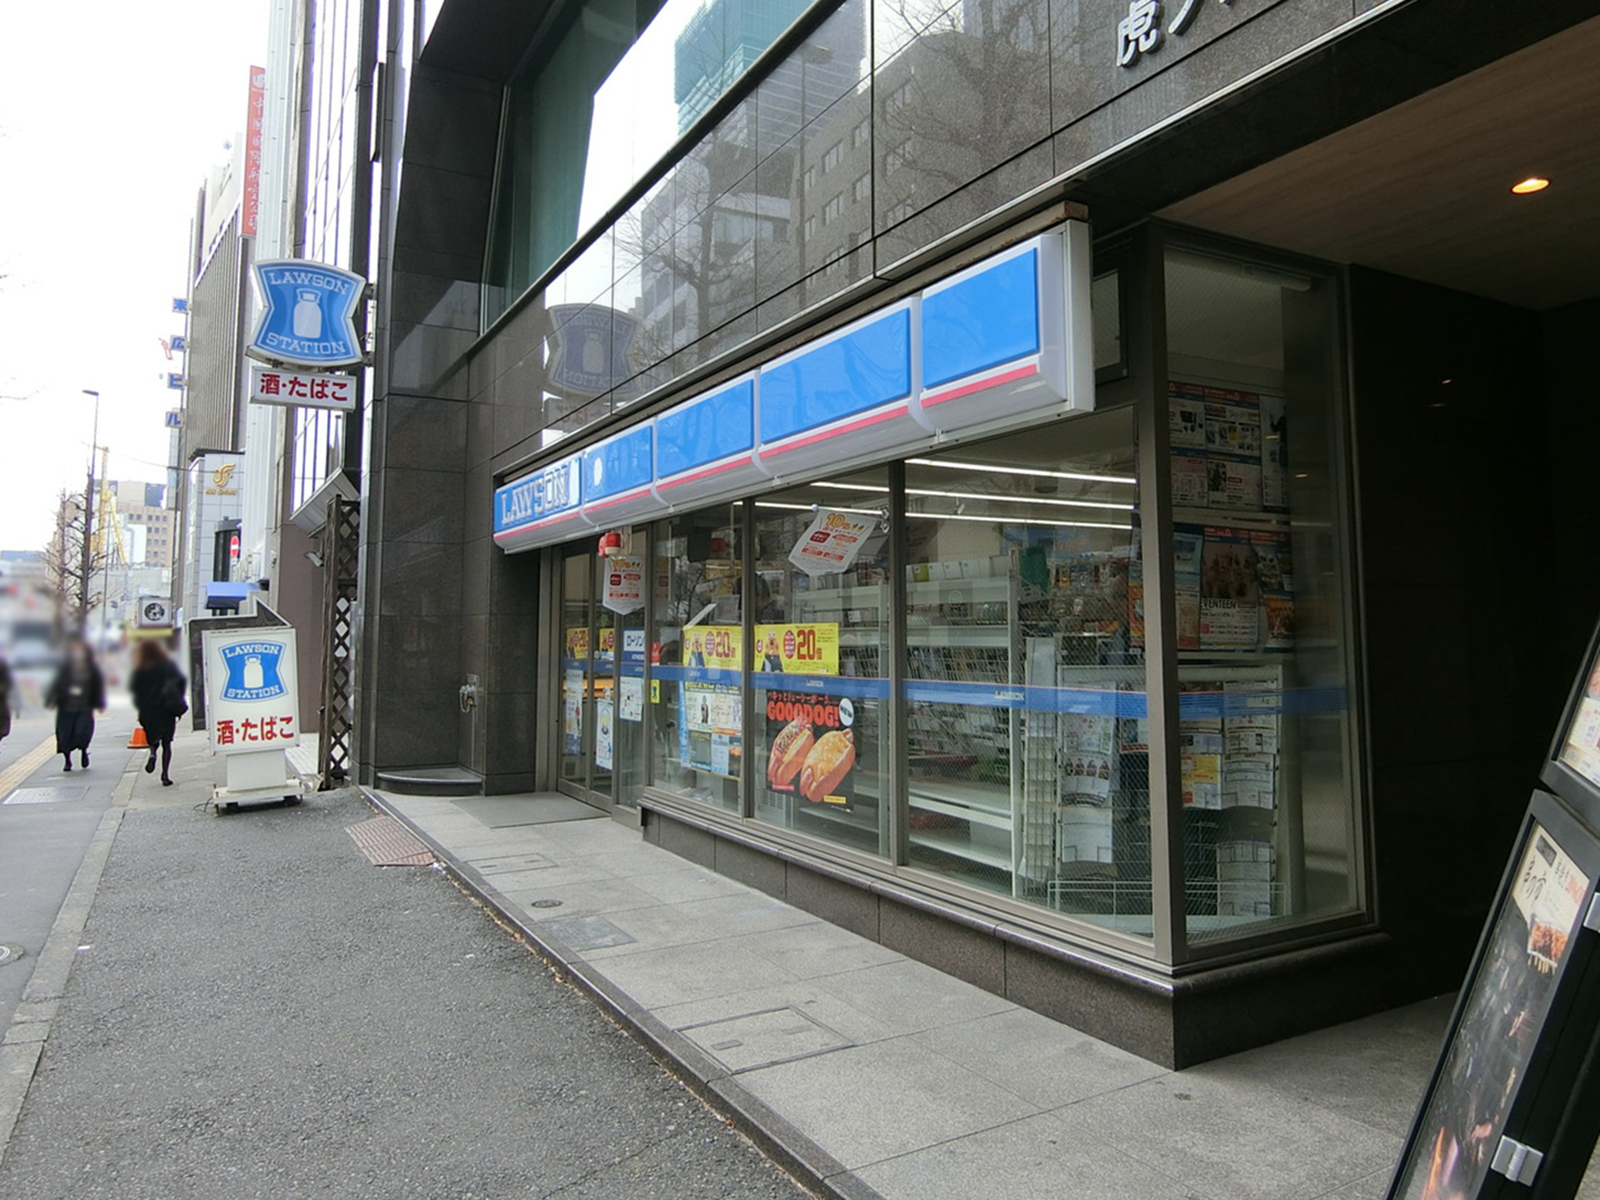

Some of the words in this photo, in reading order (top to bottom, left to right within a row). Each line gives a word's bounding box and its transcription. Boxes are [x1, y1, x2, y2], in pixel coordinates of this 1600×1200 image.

[1116, 0, 1227, 67] 虎ノ
[268, 271, 350, 296] LAWSON
[265, 332, 346, 355] STATION
[259, 372, 349, 402] 酒・たばこ
[501, 465, 568, 525] LAWSON
[1199, 599, 1237, 609] EVENTEEN
[225, 644, 280, 658] LAWSON
[227, 685, 280, 698] STATION
[767, 700, 841, 728] GOOODOG!
[216, 716, 295, 745] 酒・たばこ
